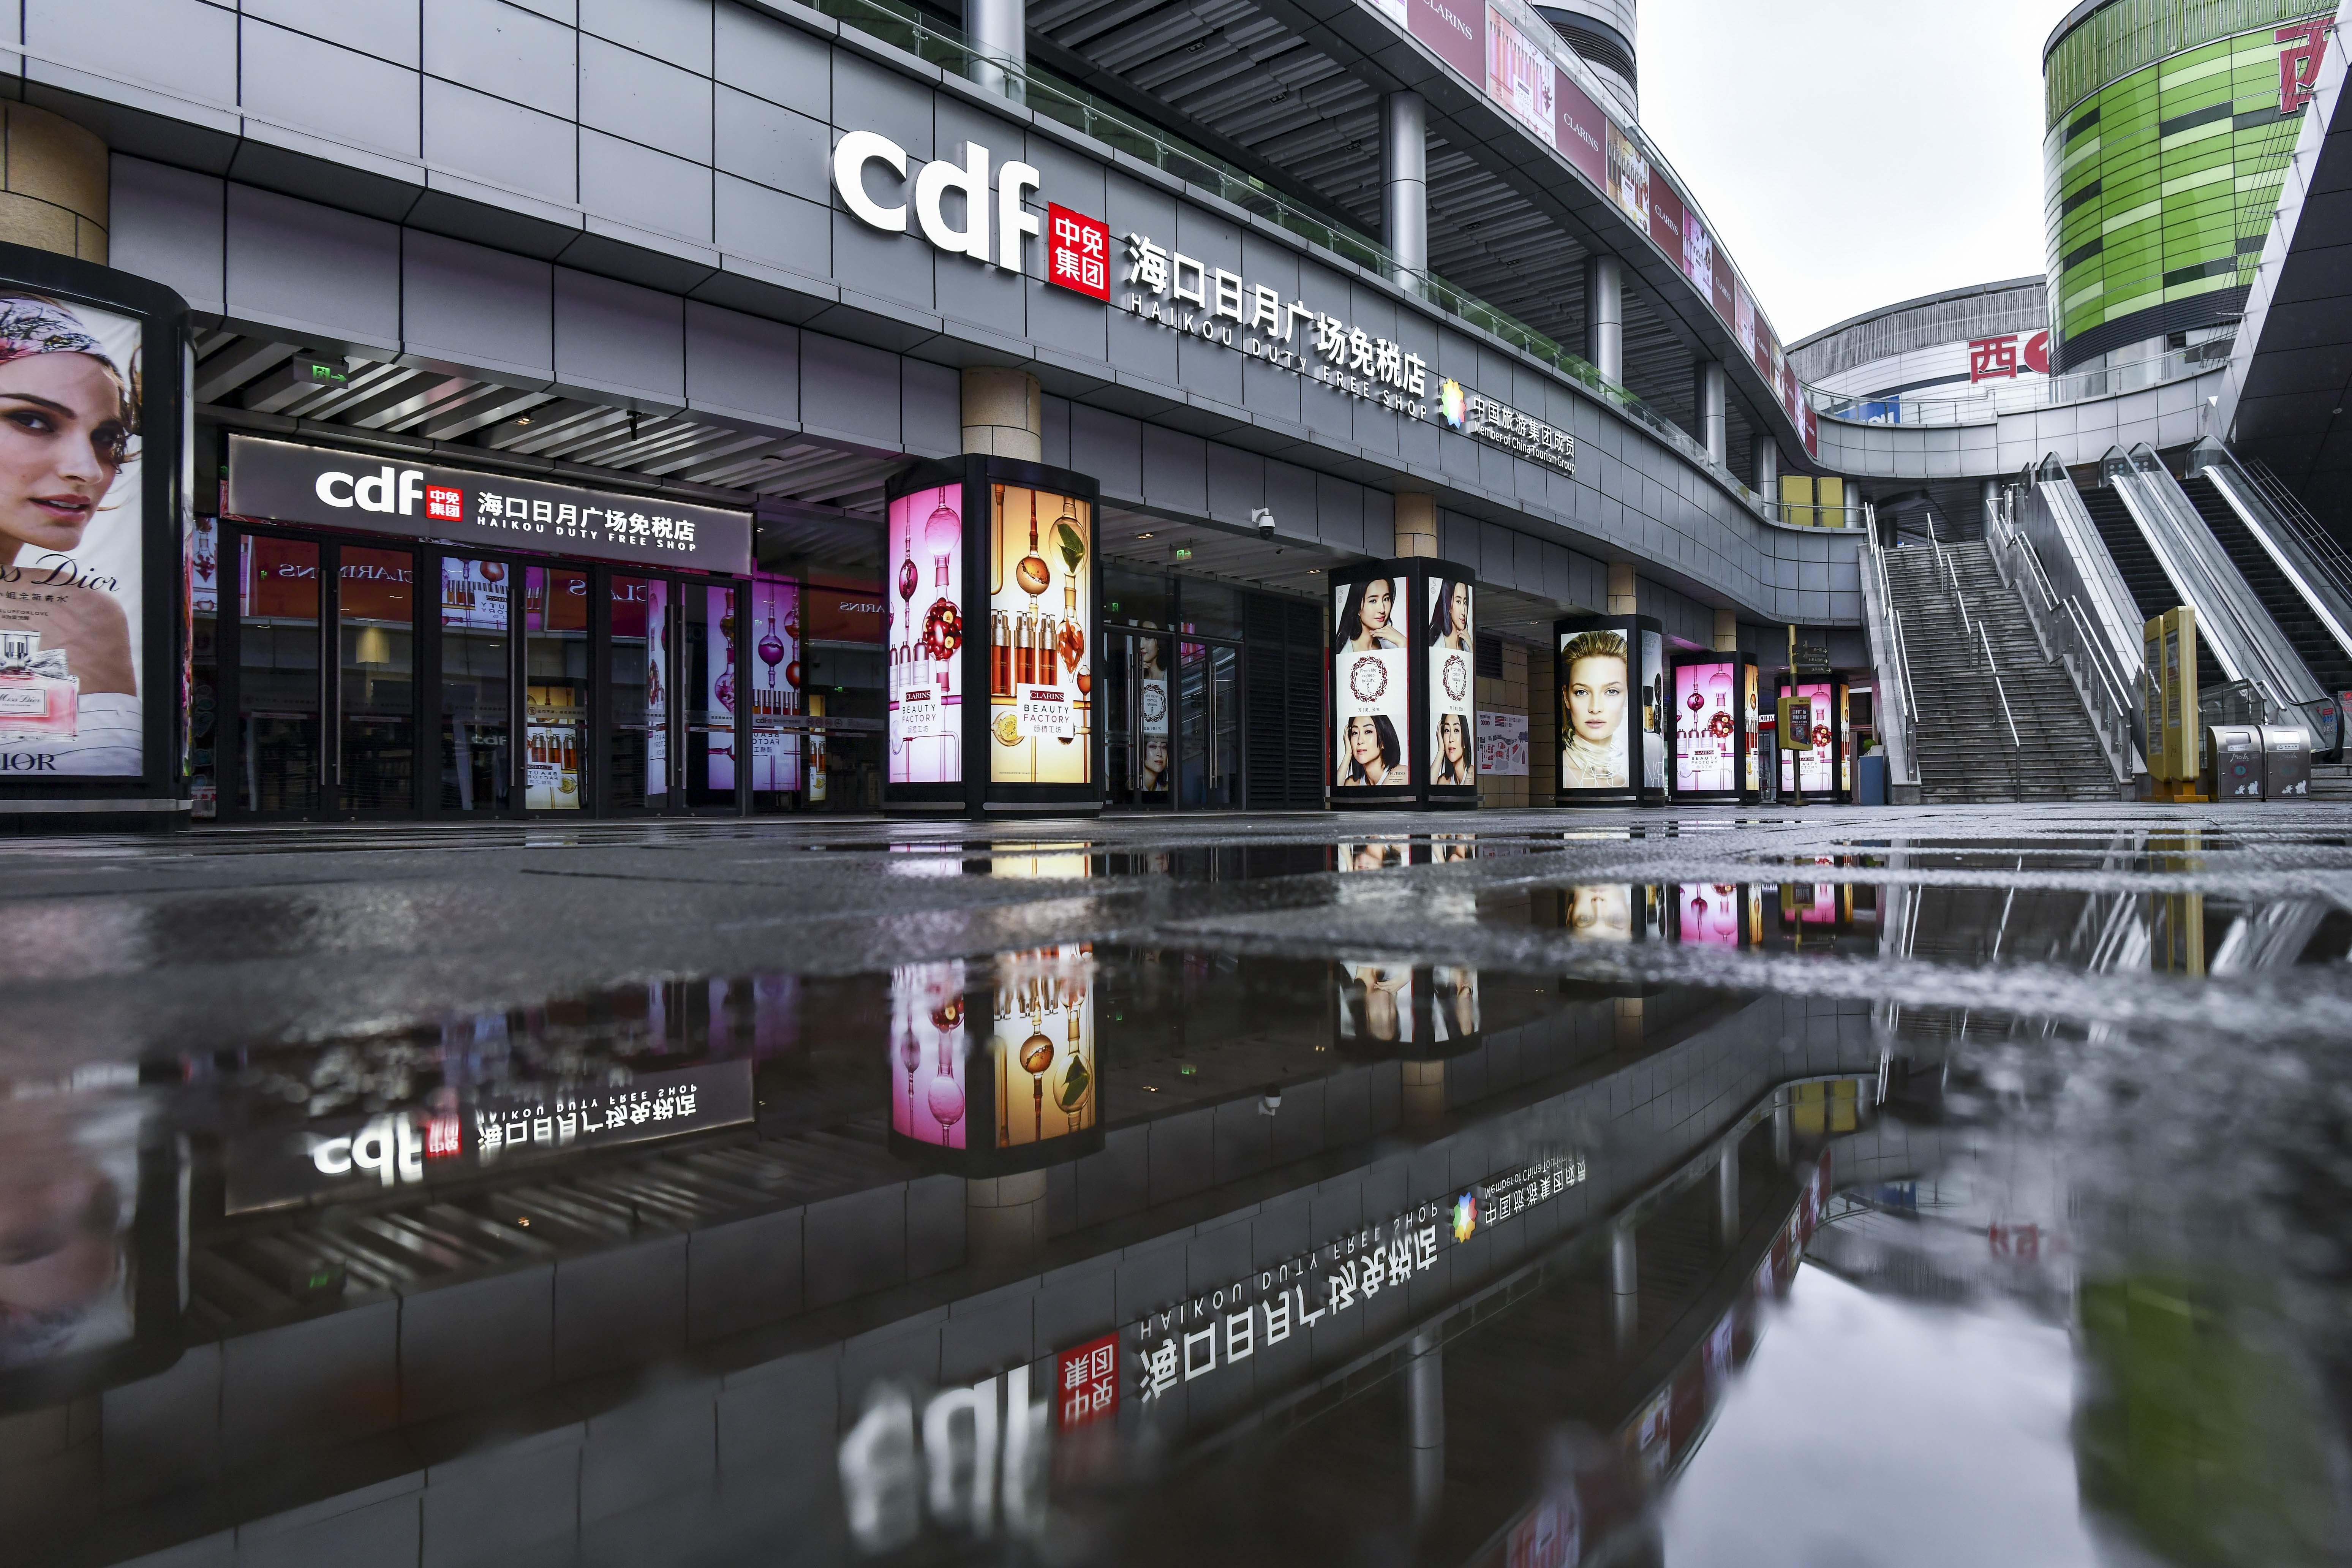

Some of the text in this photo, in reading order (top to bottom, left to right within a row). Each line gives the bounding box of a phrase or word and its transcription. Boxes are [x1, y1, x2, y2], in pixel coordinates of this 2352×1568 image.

[1423, 0, 1472, 40] LARINS
[1564, 113, 1598, 152] CLARINS
[831, 130, 1040, 274] cdf
[1655, 205, 1678, 236] CLARINS
[1055, 217, 1104, 260] 中免
[1055, 247, 1104, 290] 集团
[1715, 277, 1731, 302] CLARINS
[1127, 231, 1426, 398] 海口日月广场免税店
[1131, 292, 1427, 419] HAIKOU DUTY FREE SHOP
[1474, 394, 1574, 458] 中国旅游集团成员
[1474, 420, 1575, 474] Member of China Tourism Group
[315, 466, 424, 515] cdf
[430, 490, 459, 505] 中免
[430, 502, 460, 518] 集团
[477, 491, 695, 542] 海口日月广场免税店
[477, 516, 696, 551] HAIKOU DUTY FREE SHOP
[903, 704, 936, 714] BEAUTY
[906, 691, 931, 700] CLARINS
[1024, 704, 1069, 714] BEAUTY
[1030, 692, 1064, 700] CLARINS
[903, 714, 936, 723] FACTORY
[1024, 714, 1069, 724] FACTORY
[1034, 725, 1061, 733] 颜植工坊
[0, 753, 58, 770] IOR
[1565, 761, 1626, 788] NARS
